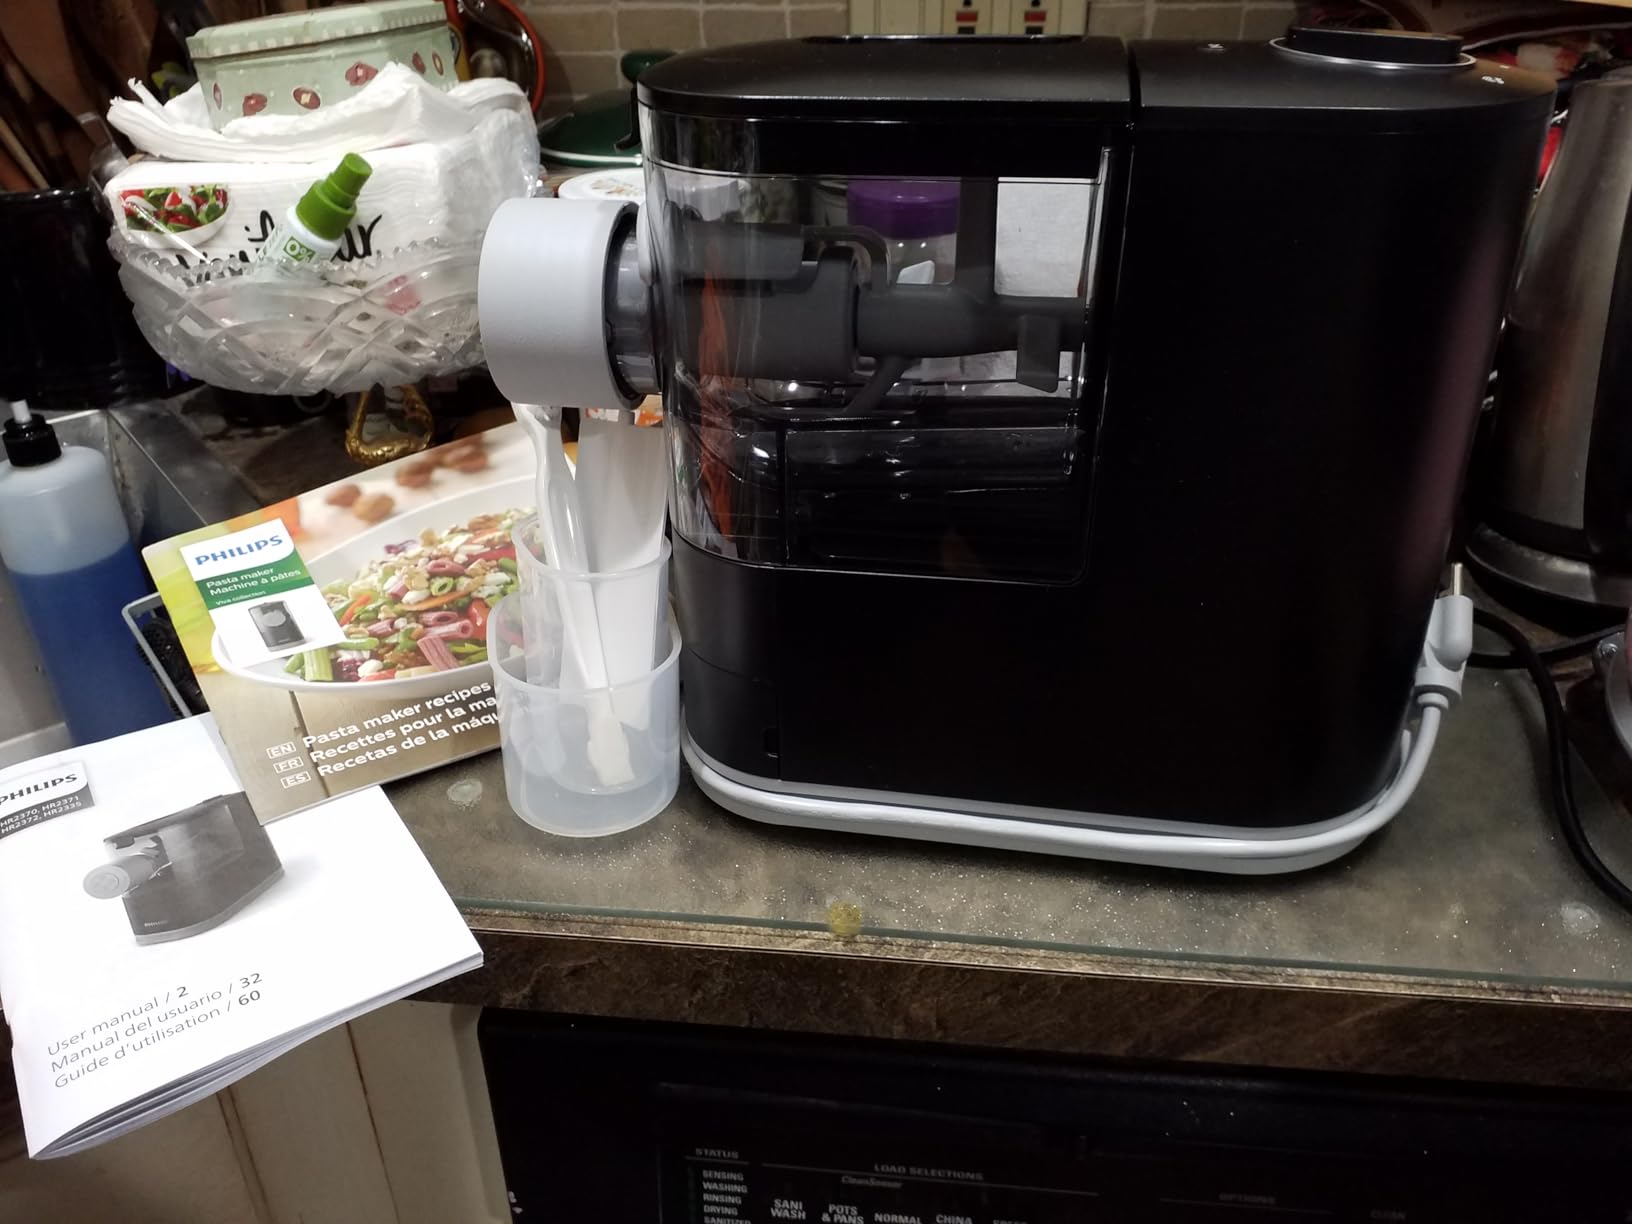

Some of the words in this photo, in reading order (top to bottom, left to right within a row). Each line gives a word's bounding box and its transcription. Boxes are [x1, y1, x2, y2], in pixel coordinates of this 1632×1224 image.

[195, 535, 283, 566] PHILIPS
[206, 576, 238, 589] Pasta
[240, 568, 274, 583] maker
[210, 580, 259, 596] Machine
[261, 576, 269, 585] à
[270, 569, 301, 584] pâtes
[215, 598, 232, 606] Viva
[232, 590, 266, 602] collection
[269, 744, 294, 757] EN
[302, 723, 360, 748] Pasta
[363, 703, 421, 730] maker
[425, 682, 492, 710] recipes
[277, 758, 300, 772] FR
[309, 729, 396, 762] Recettes
[399, 713, 443, 736] pour
[446, 706, 466, 719] la
[469, 696, 497, 712] ma
[285, 773, 307, 787] ES
[317, 744, 397, 777] Recetas
[401, 736, 426, 750] de
[429, 728, 449, 741] la
[0, 808, 40, 828] HR2370,
[42, 795, 79, 811] HR2371
[48, 1030, 87, 1056] User
[92, 996, 159, 1035] manual
[165, 992, 170, 1003] /
[176, 986, 189, 998] 2
[51, 1031, 120, 1073] Manual
[124, 1017, 152, 1037] del
[157, 990, 222, 1023] usuario
[228, 983, 233, 994] /
[239, 972, 263, 989] 32
[54, 1055, 109, 1088] Guide
[114, 1008, 220, 1060] d'utilisation
[238, 990, 261, 1006] 60
[695, 1147, 739, 1159] STATUS
[702, 1169, 744, 1181] SENSING
[874, 1163, 906, 1175] LOAD
[909, 1166, 984, 1181] SELECTIONS
[702, 1181, 748, 1193] WASHING
[703, 1193, 742, 1205] RINSING
[773, 1198, 803, 1211] SANI
[703, 1204, 738, 1216] DRYING
[770, 1207, 806, 1221] WASH
[828, 1203, 858, 1216] POTS
[821, 1212, 831, 1222] &
[833, 1213, 865, 1224] PANS
[873, 1212, 921, 1224] NORMAL
[935, 1214, 973, 1224] CHINA
